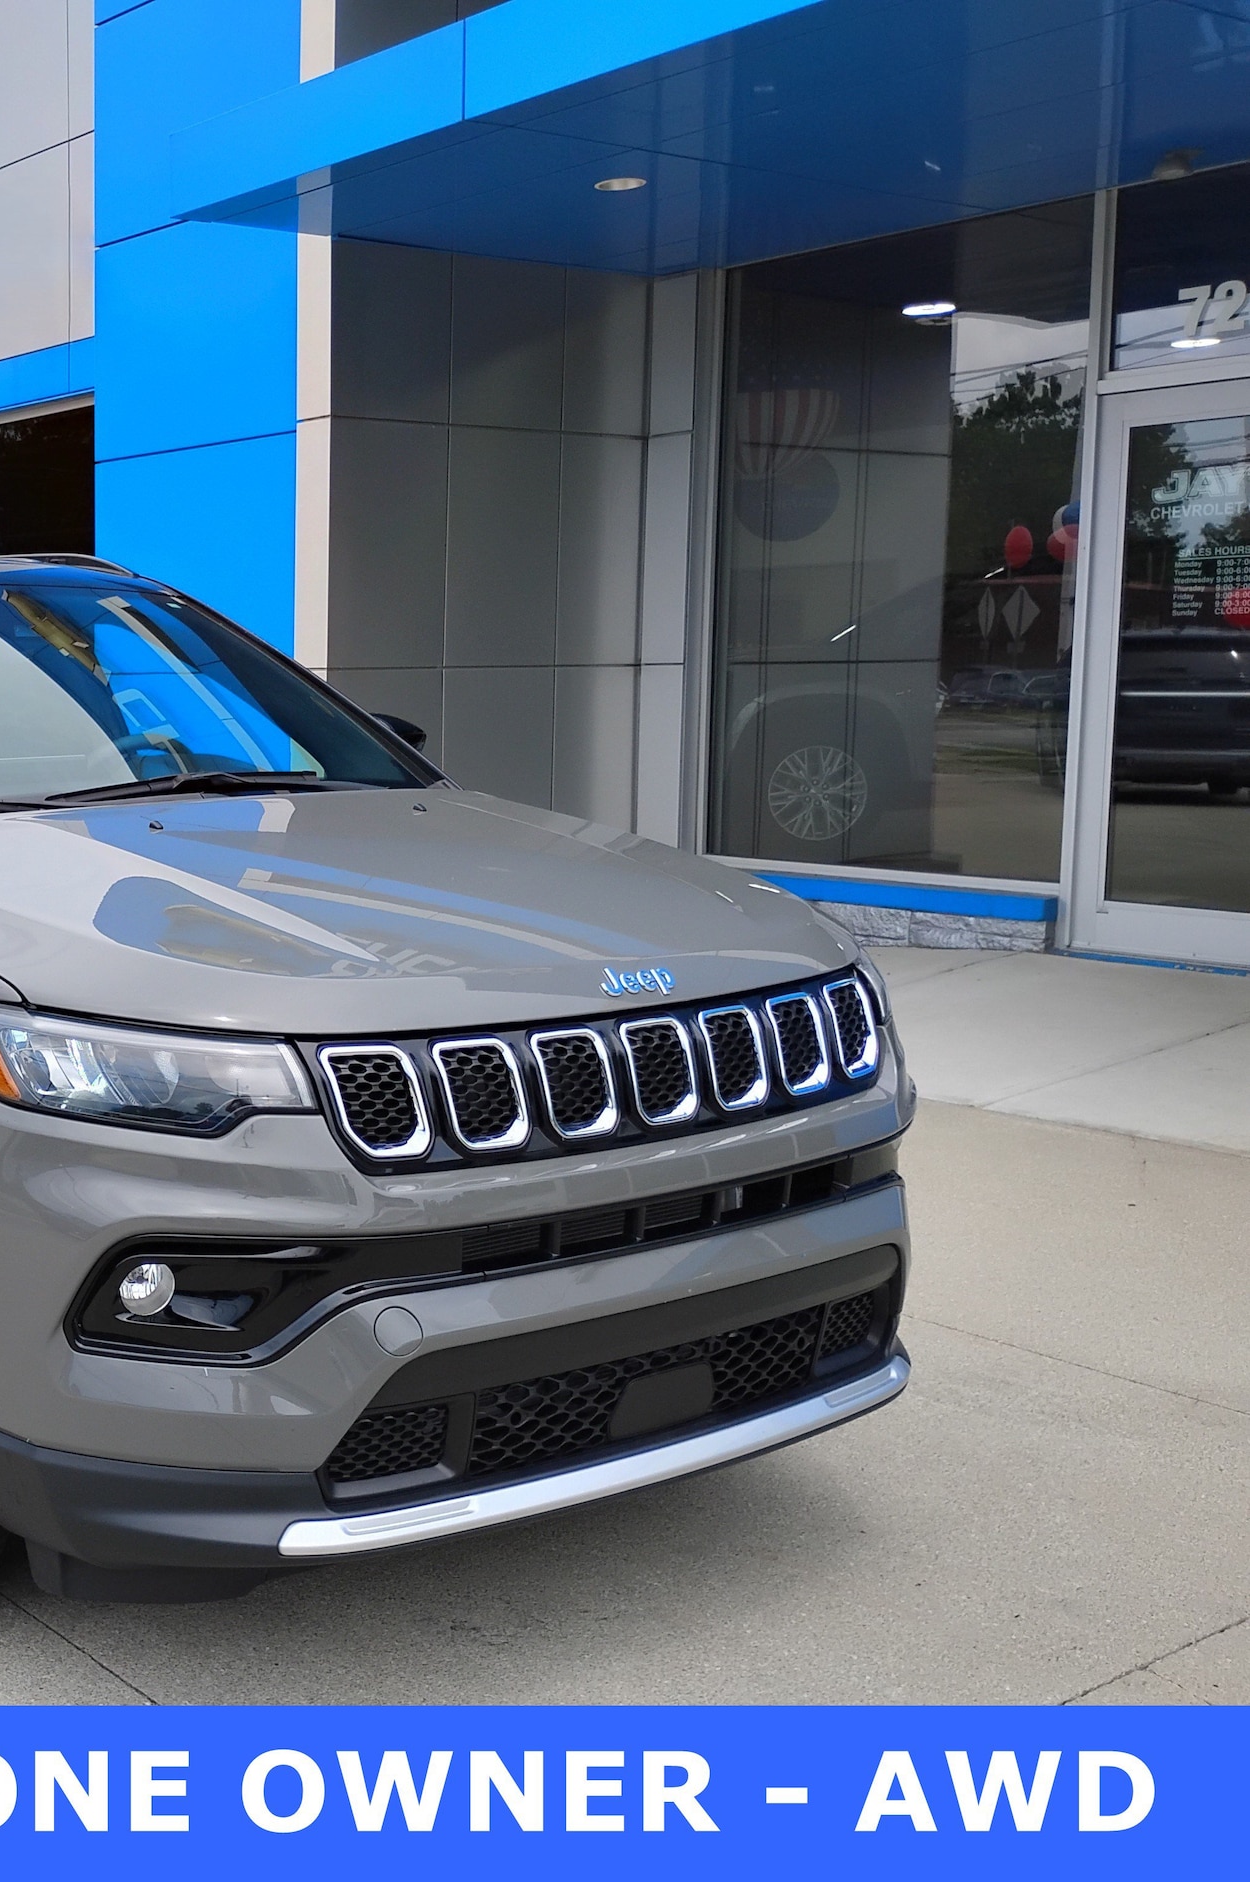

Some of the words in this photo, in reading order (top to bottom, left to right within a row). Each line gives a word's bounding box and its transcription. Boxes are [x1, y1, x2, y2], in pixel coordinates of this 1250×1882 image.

[1178, 280, 1247, 337] 72
[1150, 501, 1245, 520] CHEVROLET
[1178, 547, 1212, 557] SALES
[1216, 558, 1250, 567] 9:00-7:0
[599, 966, 677, 997] Jeep
